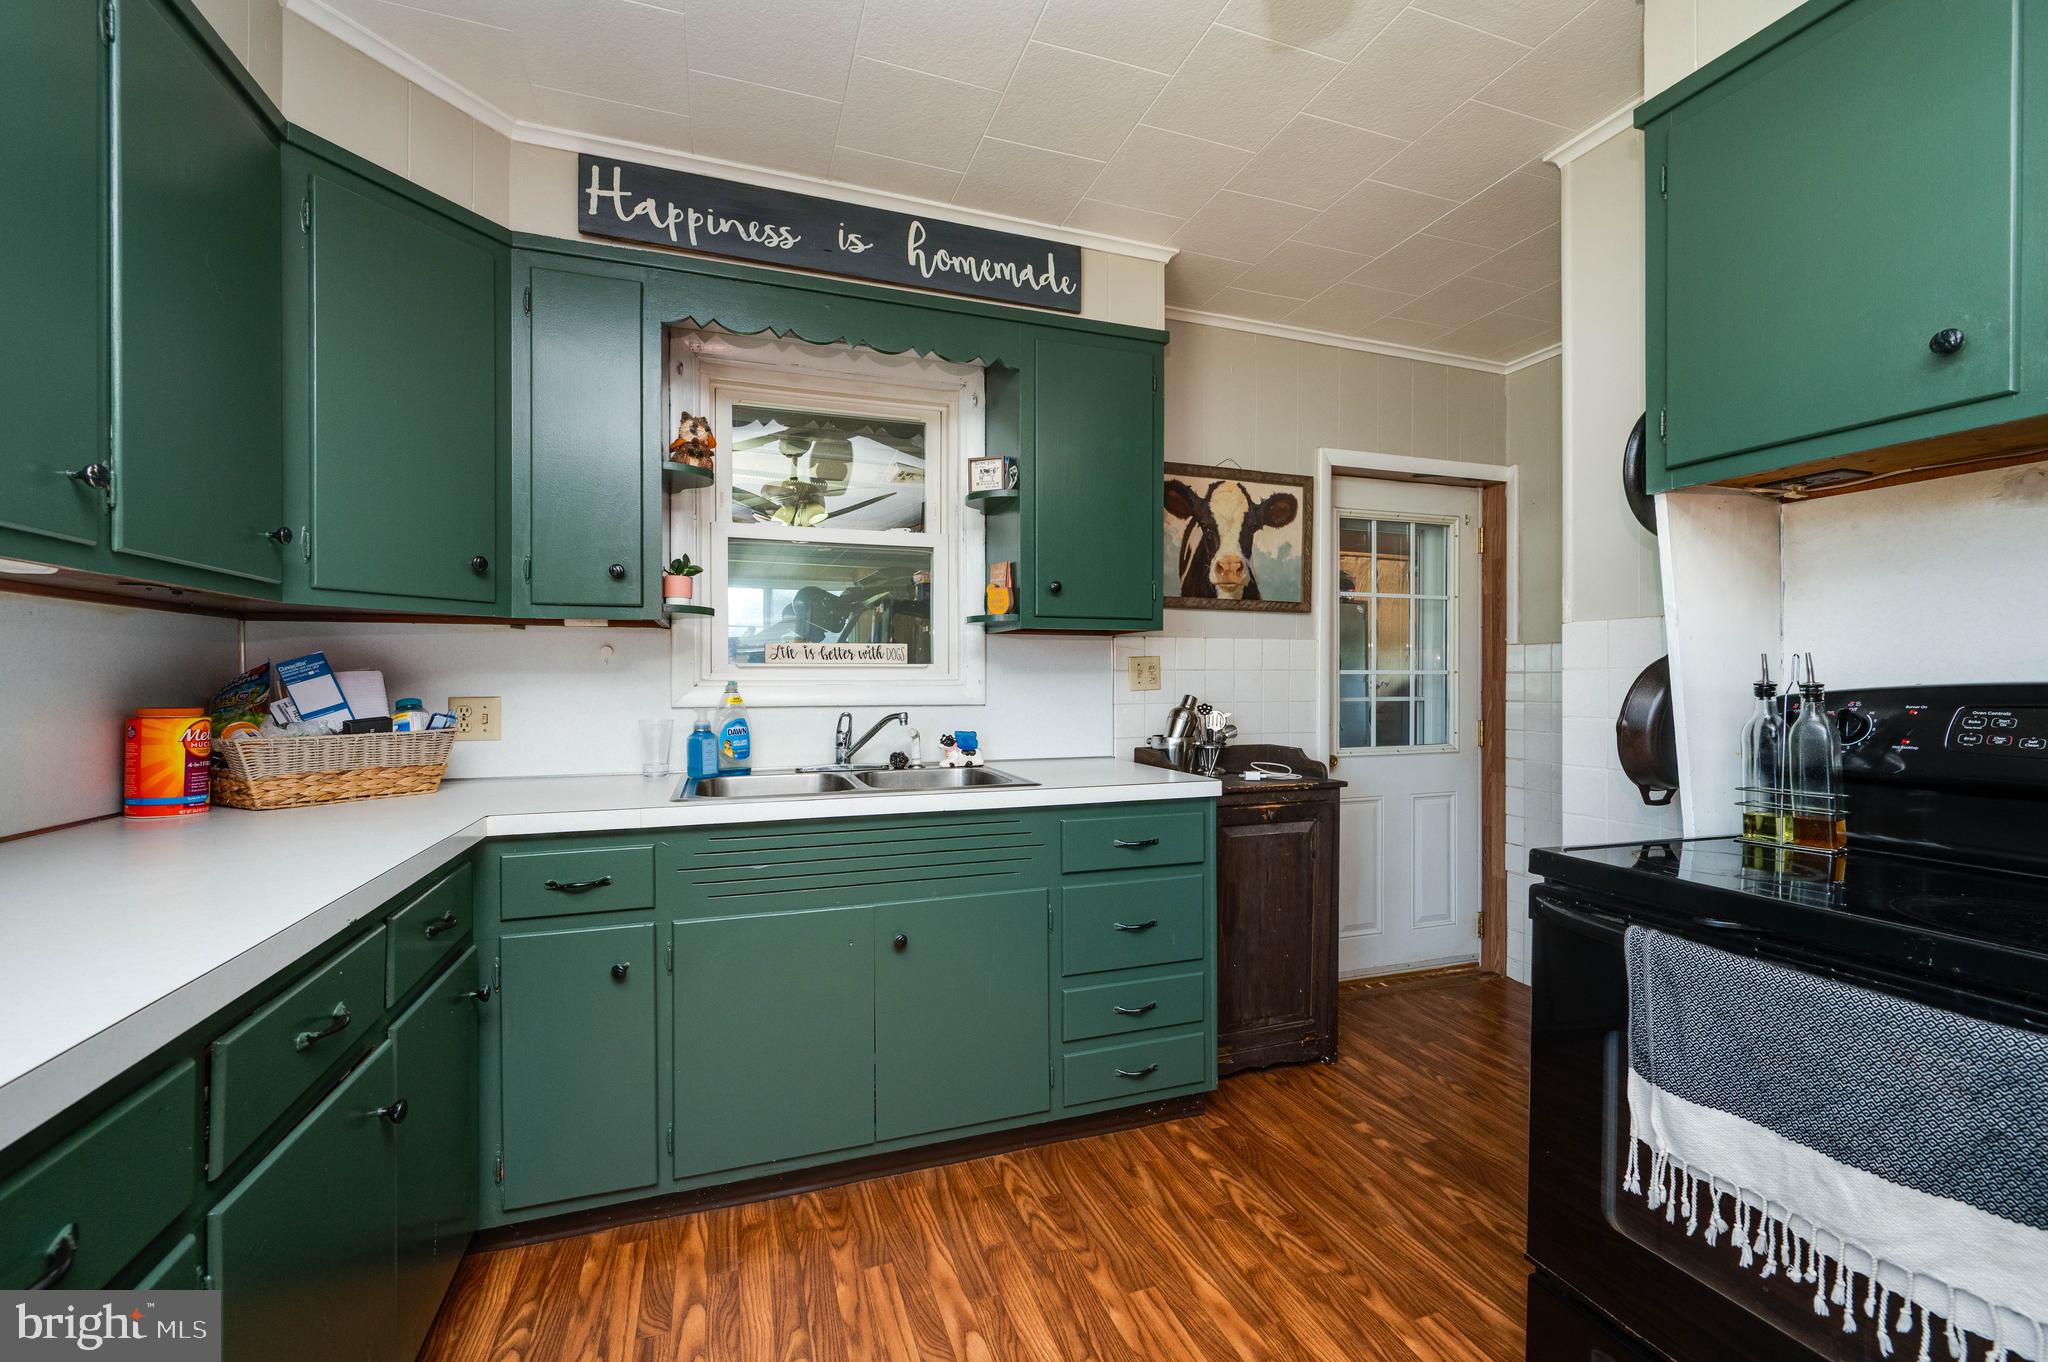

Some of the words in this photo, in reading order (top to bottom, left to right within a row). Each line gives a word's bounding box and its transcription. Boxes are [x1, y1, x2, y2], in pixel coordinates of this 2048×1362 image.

[586, 165, 801, 249] Happiness
[838, 222, 873, 254] is
[908, 220, 1077, 296] homemade
[770, 645, 799, 660] Life
[802, 645, 815, 660] is
[819, 645, 855, 661] better
[858, 645, 885, 660] with
[886, 646, 905, 662] DOGS
[727, 727, 747, 736] DAWN
